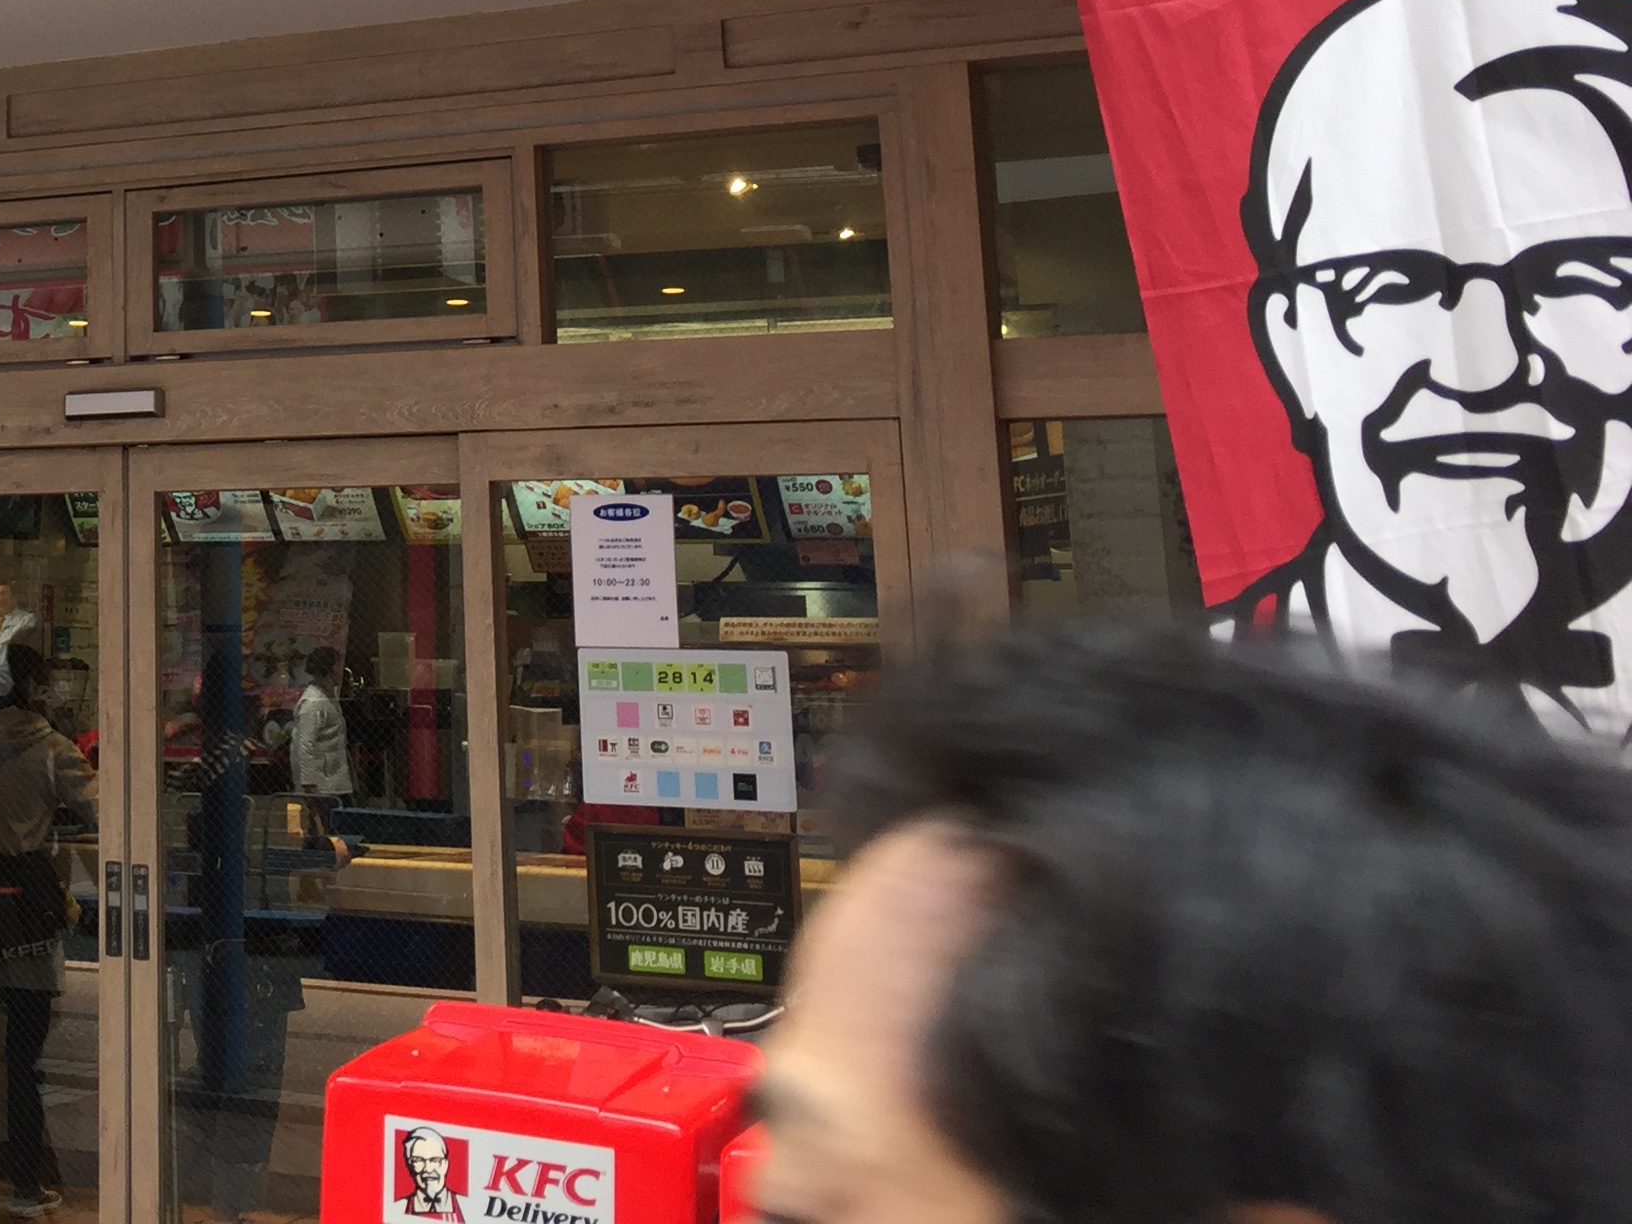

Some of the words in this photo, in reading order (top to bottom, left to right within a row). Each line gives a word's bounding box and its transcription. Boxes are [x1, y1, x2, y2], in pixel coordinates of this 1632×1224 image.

[599, 507, 642, 518] お客様各位
[606, 901, 749, 934] 100%国内産
[631, 951, 683, 969] 鹿児島県
[710, 956, 757, 976] 岩手県
[483, 1154, 601, 1207] KFC
